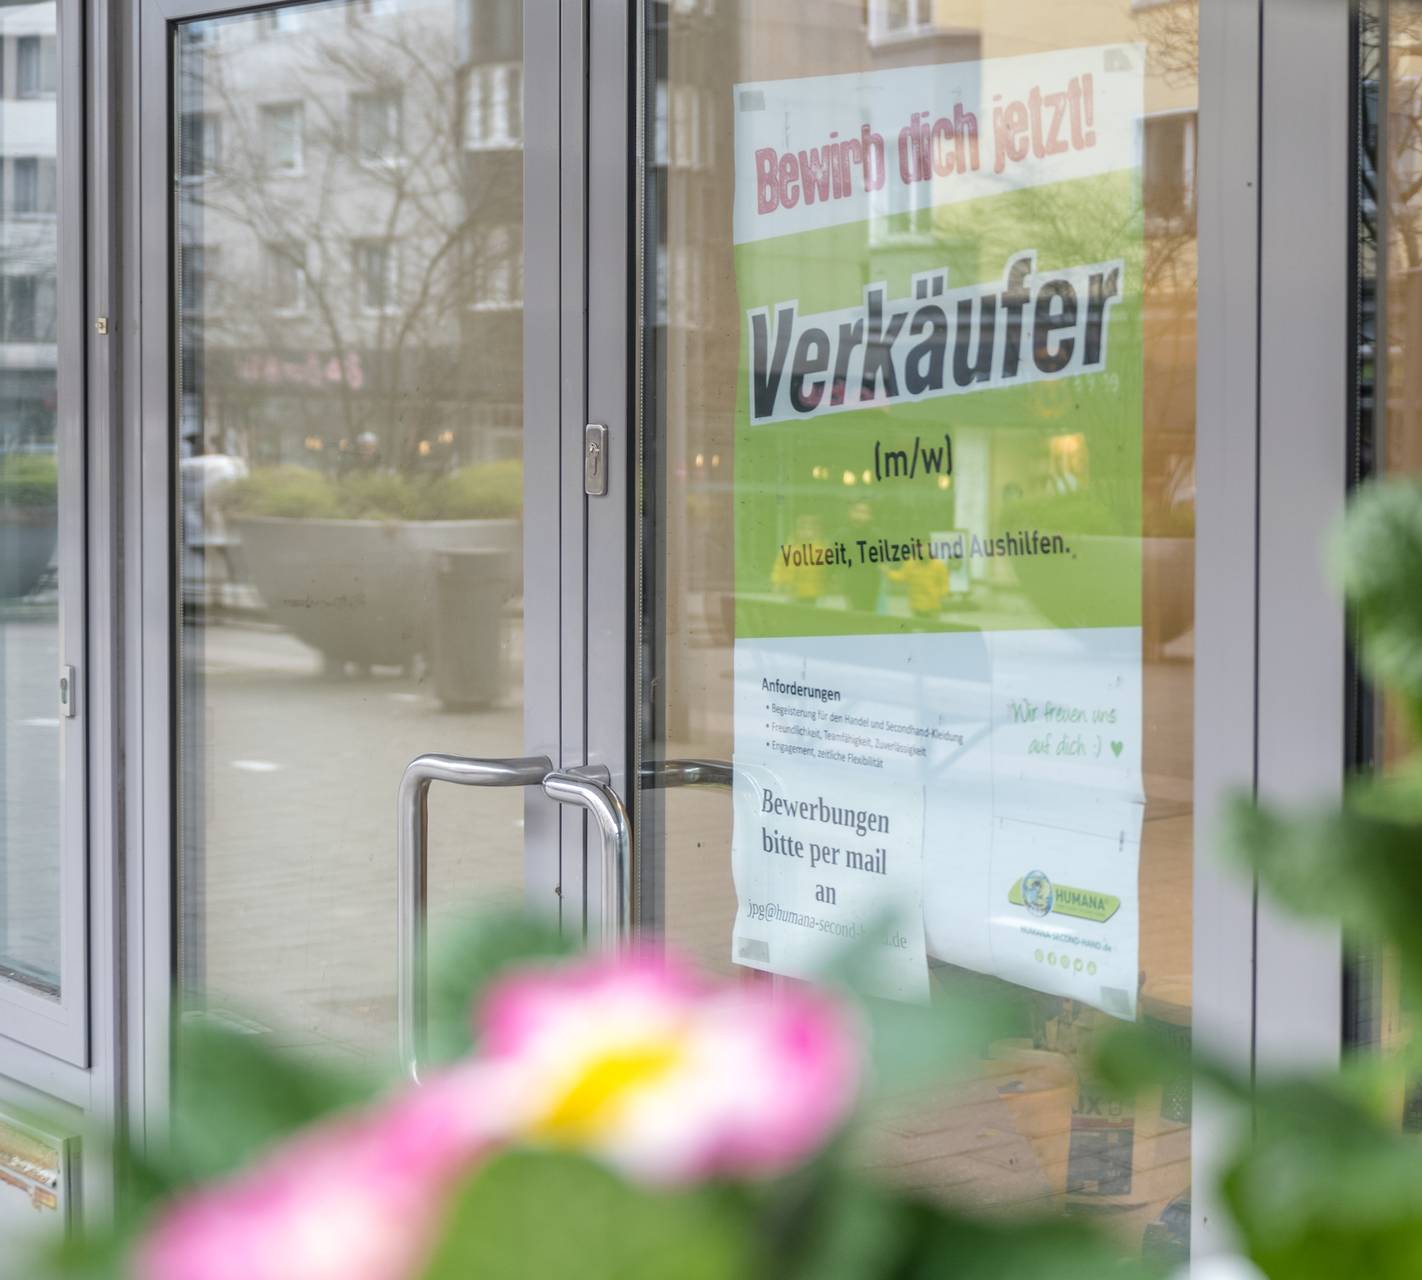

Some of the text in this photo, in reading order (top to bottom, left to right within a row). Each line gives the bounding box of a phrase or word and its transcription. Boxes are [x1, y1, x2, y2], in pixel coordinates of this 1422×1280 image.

[754, 73, 1097, 215] Bewirb dich jetzt!
[751, 256, 1119, 419] Verkäufer
[874, 434, 953, 481] (m/w)
[781, 530, 1071, 568] Vollzeit, Teilzeit und Aushilfen.
[761, 677, 841, 703] Anforderungen
[771, 703, 816, 721] Begeisterung
[817, 708, 828, 721] für
[829, 711, 843, 723] den
[844, 714, 869, 727] Handel
[871, 719, 884, 730] und
[1007, 698, 1117, 724] Wir freuen uns
[771, 740, 815, 757] Engagement,
[817, 747, 845, 762] zeitliche
[1028, 733, 1052, 754] auf
[1056, 733, 1087, 756] dich
[761, 788, 890, 837] Bewerbungen
[761, 827, 887, 875] bitte per mail
[815, 884, 837, 905] an
[1055, 889, 1105, 910] HUMANA
[747, 896, 908, 949] jpg@humana-second-.de
